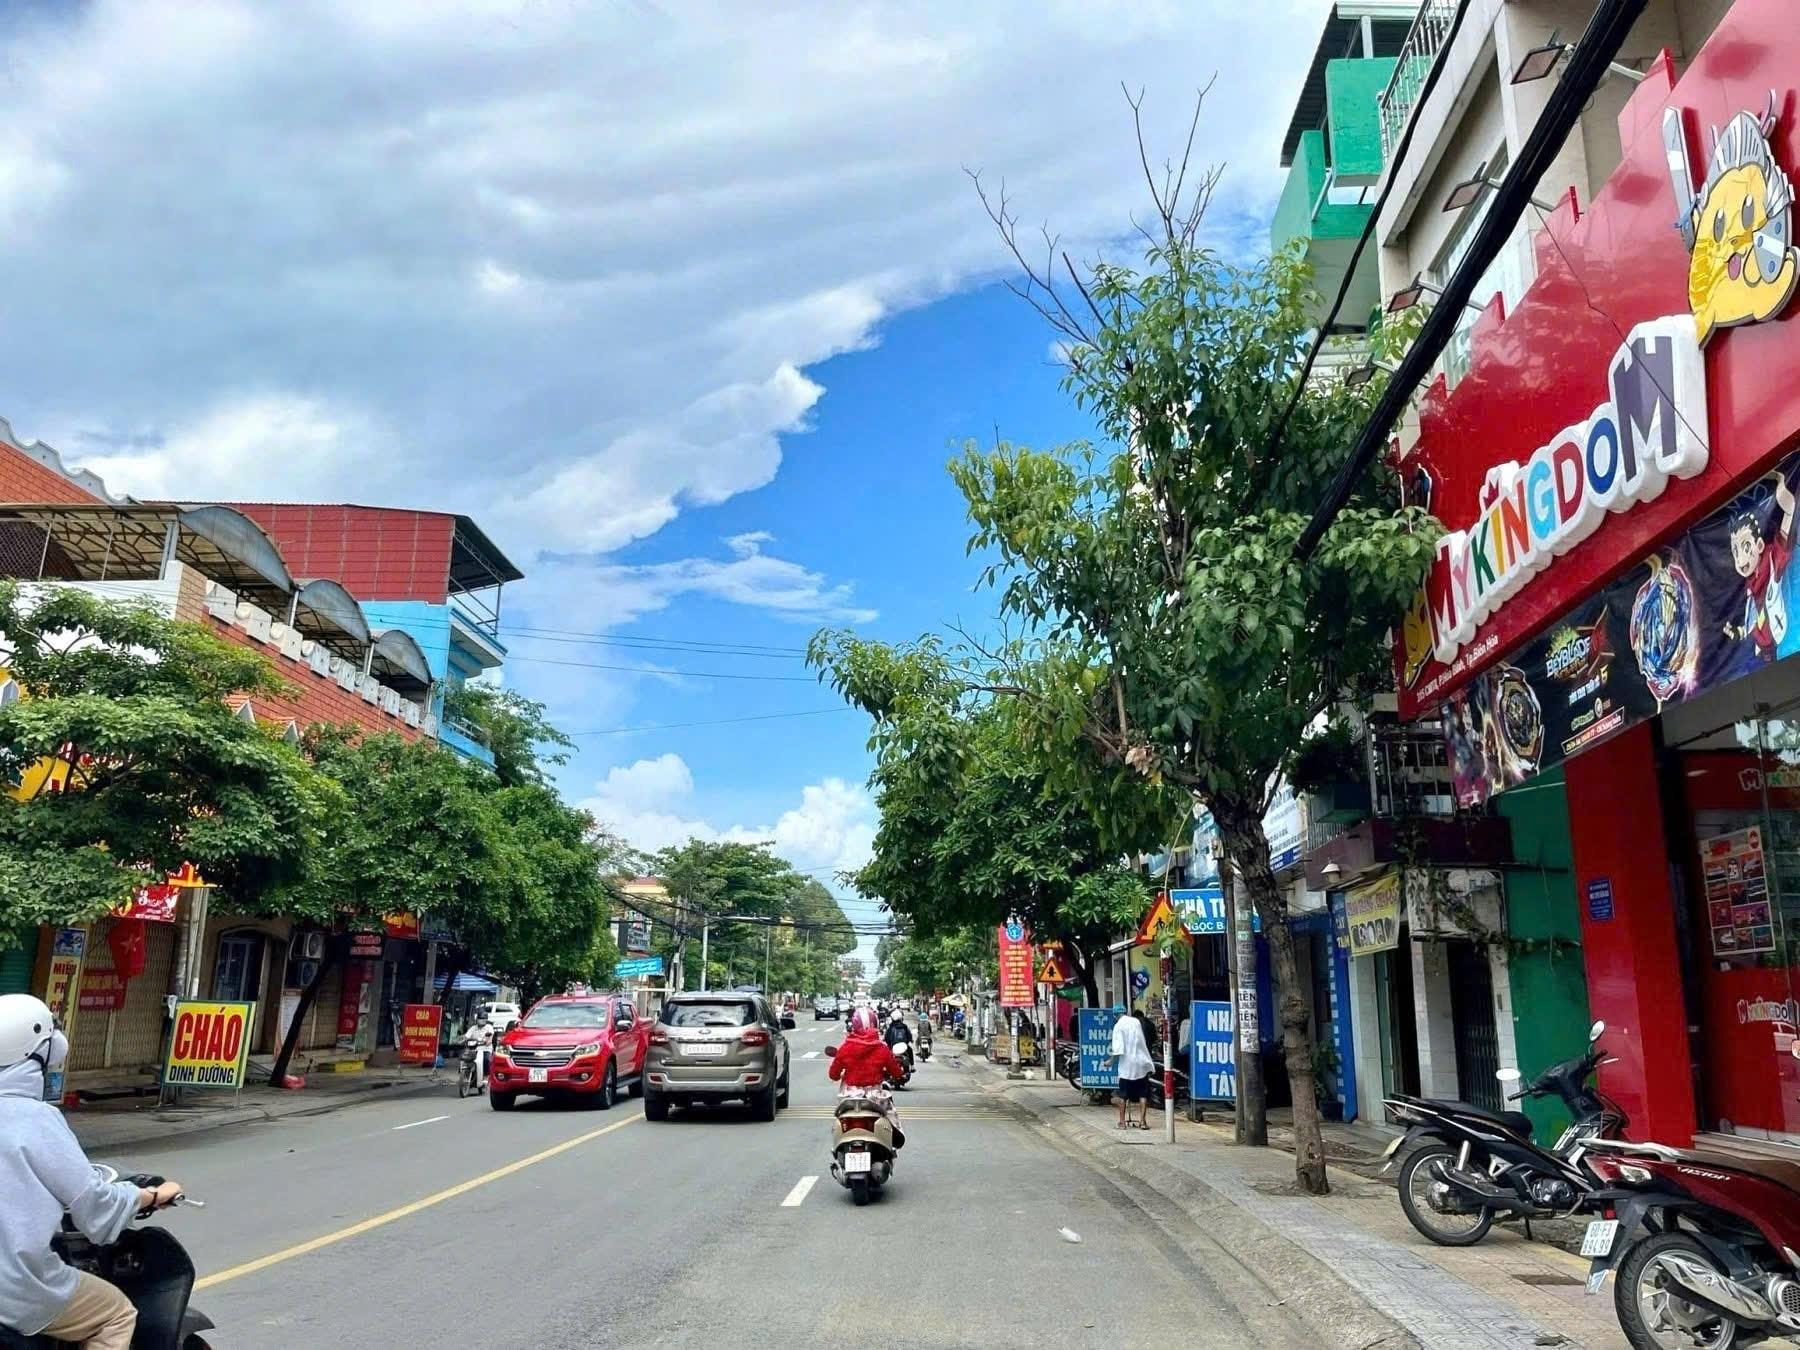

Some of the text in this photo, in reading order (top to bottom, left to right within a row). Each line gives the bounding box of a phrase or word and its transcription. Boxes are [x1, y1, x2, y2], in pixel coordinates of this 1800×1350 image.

[1425, 333, 1684, 660] MYKINGDOM
[1546, 636, 1591, 678] BEYBLADE
[174, 1006, 243, 1062] CHÁO
[1196, 1041, 1235, 1064] THU
[169, 1063, 235, 1083] DINH DƯỠNG
[1677, 1166, 1731, 1181] VISION
